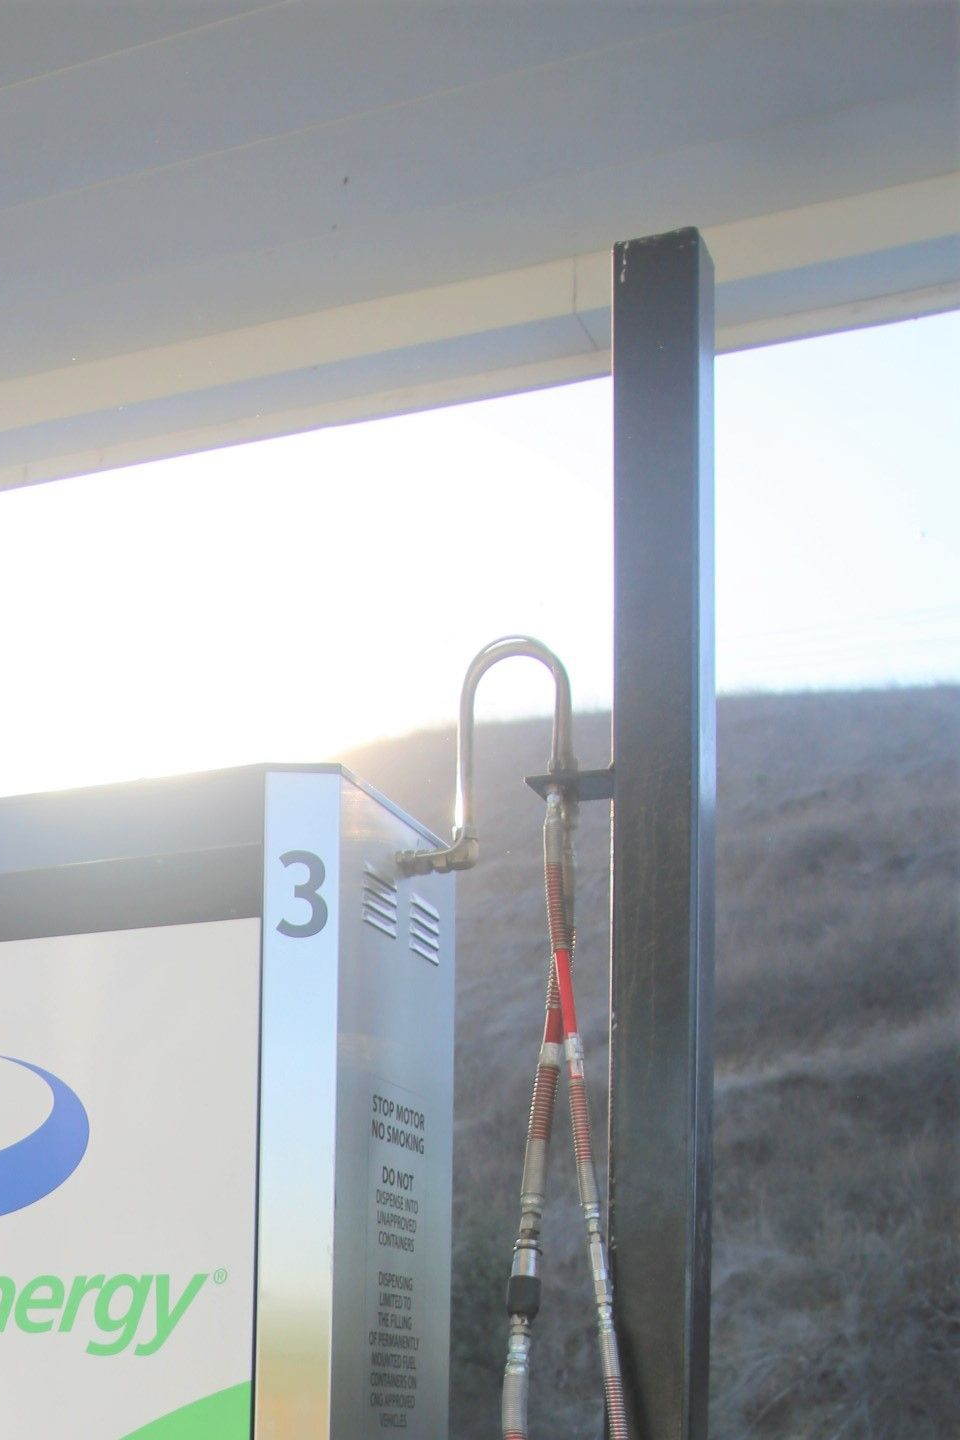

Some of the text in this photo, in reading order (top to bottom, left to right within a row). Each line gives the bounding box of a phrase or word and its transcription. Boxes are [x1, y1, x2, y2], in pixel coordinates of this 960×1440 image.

[276, 850, 328, 938] 3
[372, 1094, 424, 1130] STOP MOTOR
[372, 1120, 424, 1154] NO SMOKING
[382, 1166, 414, 1191] DO NOT
[376, 1189, 418, 1215] DISPENSE INTO
[377, 1211, 417, 1233] UNAPPROVED
[378, 1231, 414, 1253] CONTAINERS
[378, 1271, 413, 1291] DISPENSING
[380, 1292, 411, 1311] LIMITED TO
[378, 1311, 412, 1330] THE FILLING
[368, 1332, 419, 1351] OF PERMANENTLY
[371, 1372, 407, 1389] CONTAINERS
